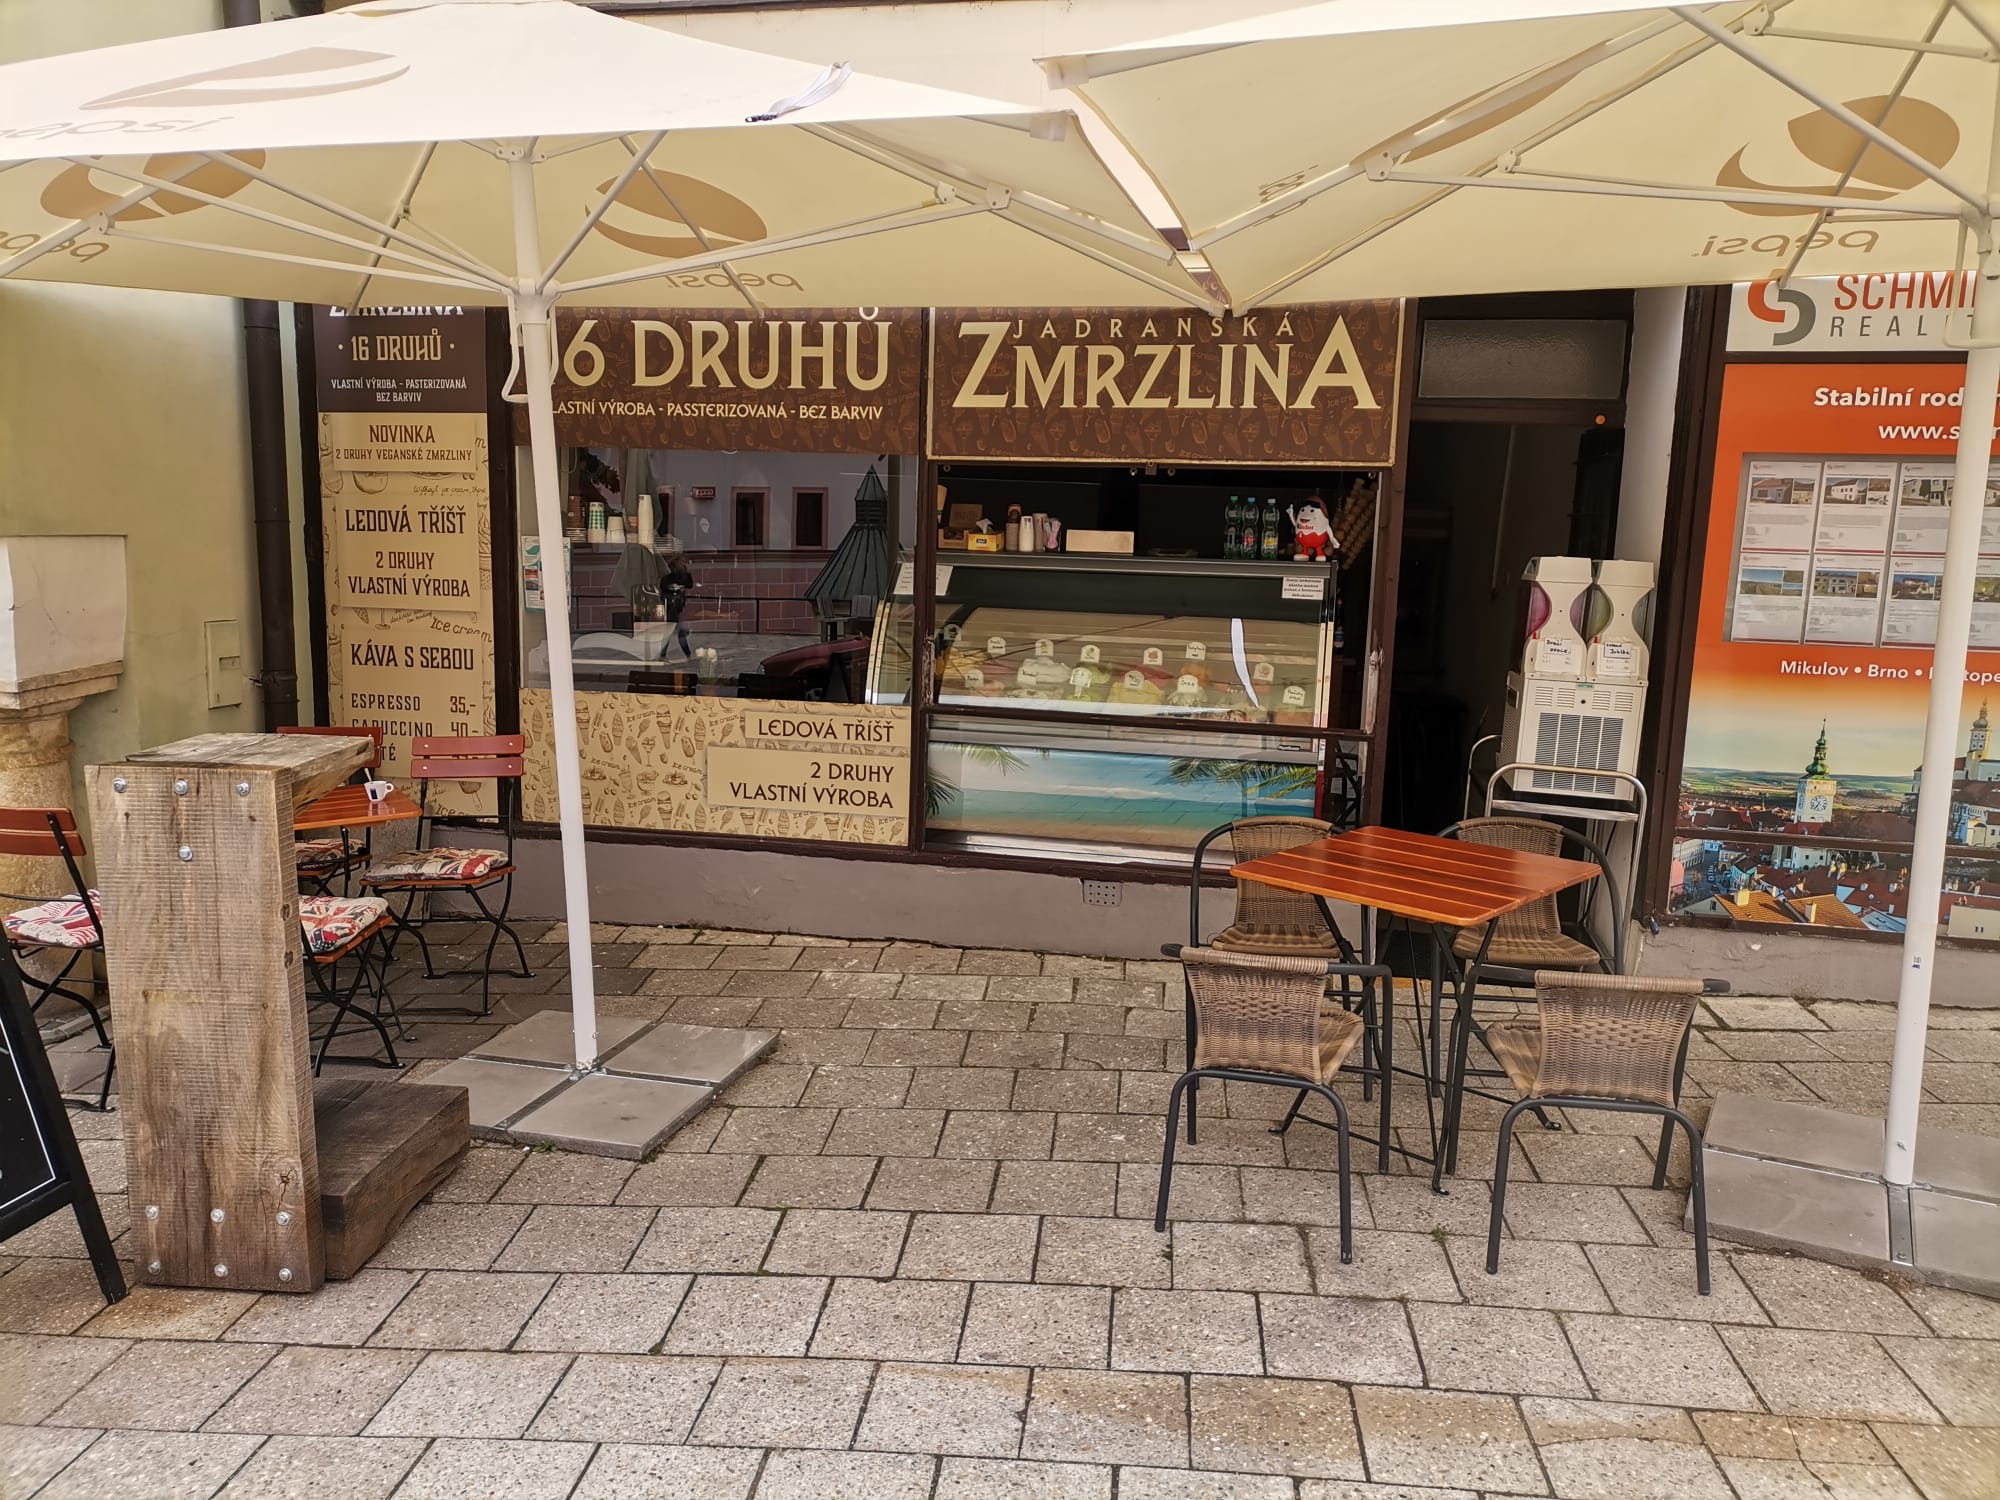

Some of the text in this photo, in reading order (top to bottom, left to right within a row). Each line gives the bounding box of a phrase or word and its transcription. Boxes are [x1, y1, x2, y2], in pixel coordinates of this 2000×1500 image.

[1834, 271, 1976, 311] SCHMI
[1013, 312, 1295, 338] JADRANSKÁ
[1830, 315, 1974, 338] REAL
[351, 328, 442, 361] 16 DRUHŮ
[552, 307, 892, 391] 6 DRUHŮ
[952, 314, 1382, 411] ZMRZLINA
[331, 376, 364, 389] VLASTNÍ
[366, 376, 397, 389] VÝROBA
[406, 376, 467, 389] PASTERIZOVANÁ
[376, 391, 422, 402] BEZ BARVIV
[1814, 386, 1964, 407] Stabilní rod
[552, 398, 595, 415] ASTNÍ
[599, 399, 656, 416] VÝROBA
[667, 401, 788, 418] PASSTERIZOVANÁ
[799, 405, 827, 420] BEZ
[831, 406, 883, 420] BARVIV
[369, 424, 436, 444] NOVINKA
[1878, 425, 1961, 440] www.s
[335, 446, 472, 461] 2 DRUHY VEGANSKÉ ZMRZLINY
[345, 504, 467, 534] LEDOVÁ TŘÍŠŤ
[375, 551, 435, 570] 2 DRUHY
[348, 574, 471, 598] VLASTNÍ VÝROBA
[351, 639, 474, 670] KÁVA S SEBOU
[1781, 661, 1849, 676] Mikulov
[1868, 664, 1909, 679] Brno
[352, 693, 477, 716] ESPRESSO 35,-
[451, 721, 479, 738] 40-
[758, 719, 895, 742] LEDOVÁ TŘÍŠŤ
[810, 761, 895, 783] 2 DRUHY
[730, 782, 894, 808] VLASTNÍ VÝROBA
